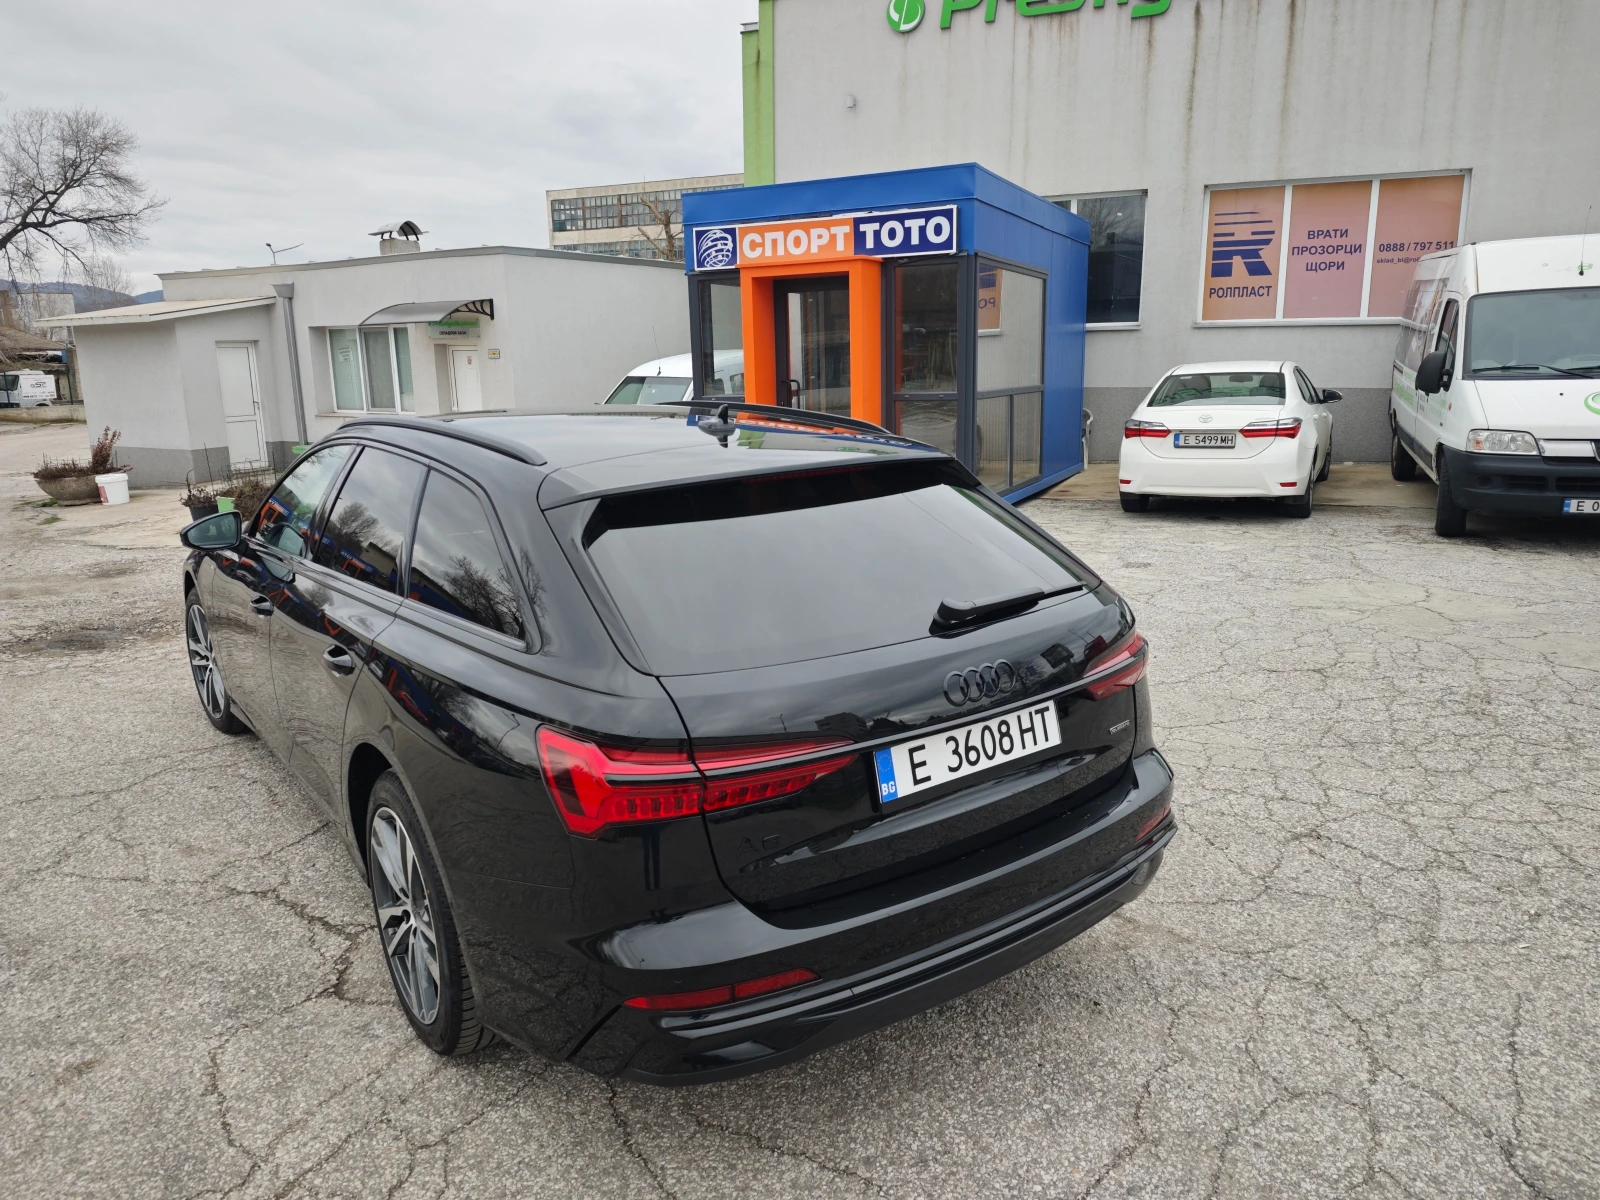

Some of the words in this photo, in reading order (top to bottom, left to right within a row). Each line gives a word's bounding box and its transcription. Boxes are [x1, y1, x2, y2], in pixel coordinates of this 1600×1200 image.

[742, 225, 850, 258] СПОРТ
[859, 215, 950, 249] ТОТО
[1307, 228, 1349, 240] ВРАТИ
[1291, 243, 1362, 256] ПРОЗОРЦИ
[1378, 242, 1405, 253] 0888
[1413, 241, 1433, 251] 797
[1435, 240, 1454, 251] 511
[1305, 260, 1345, 273] ЩОРИ
[1209, 285, 1273, 299] РОЛПЛАСТ
[907, 743, 932, 786] E
[881, 780, 896, 796] BG
